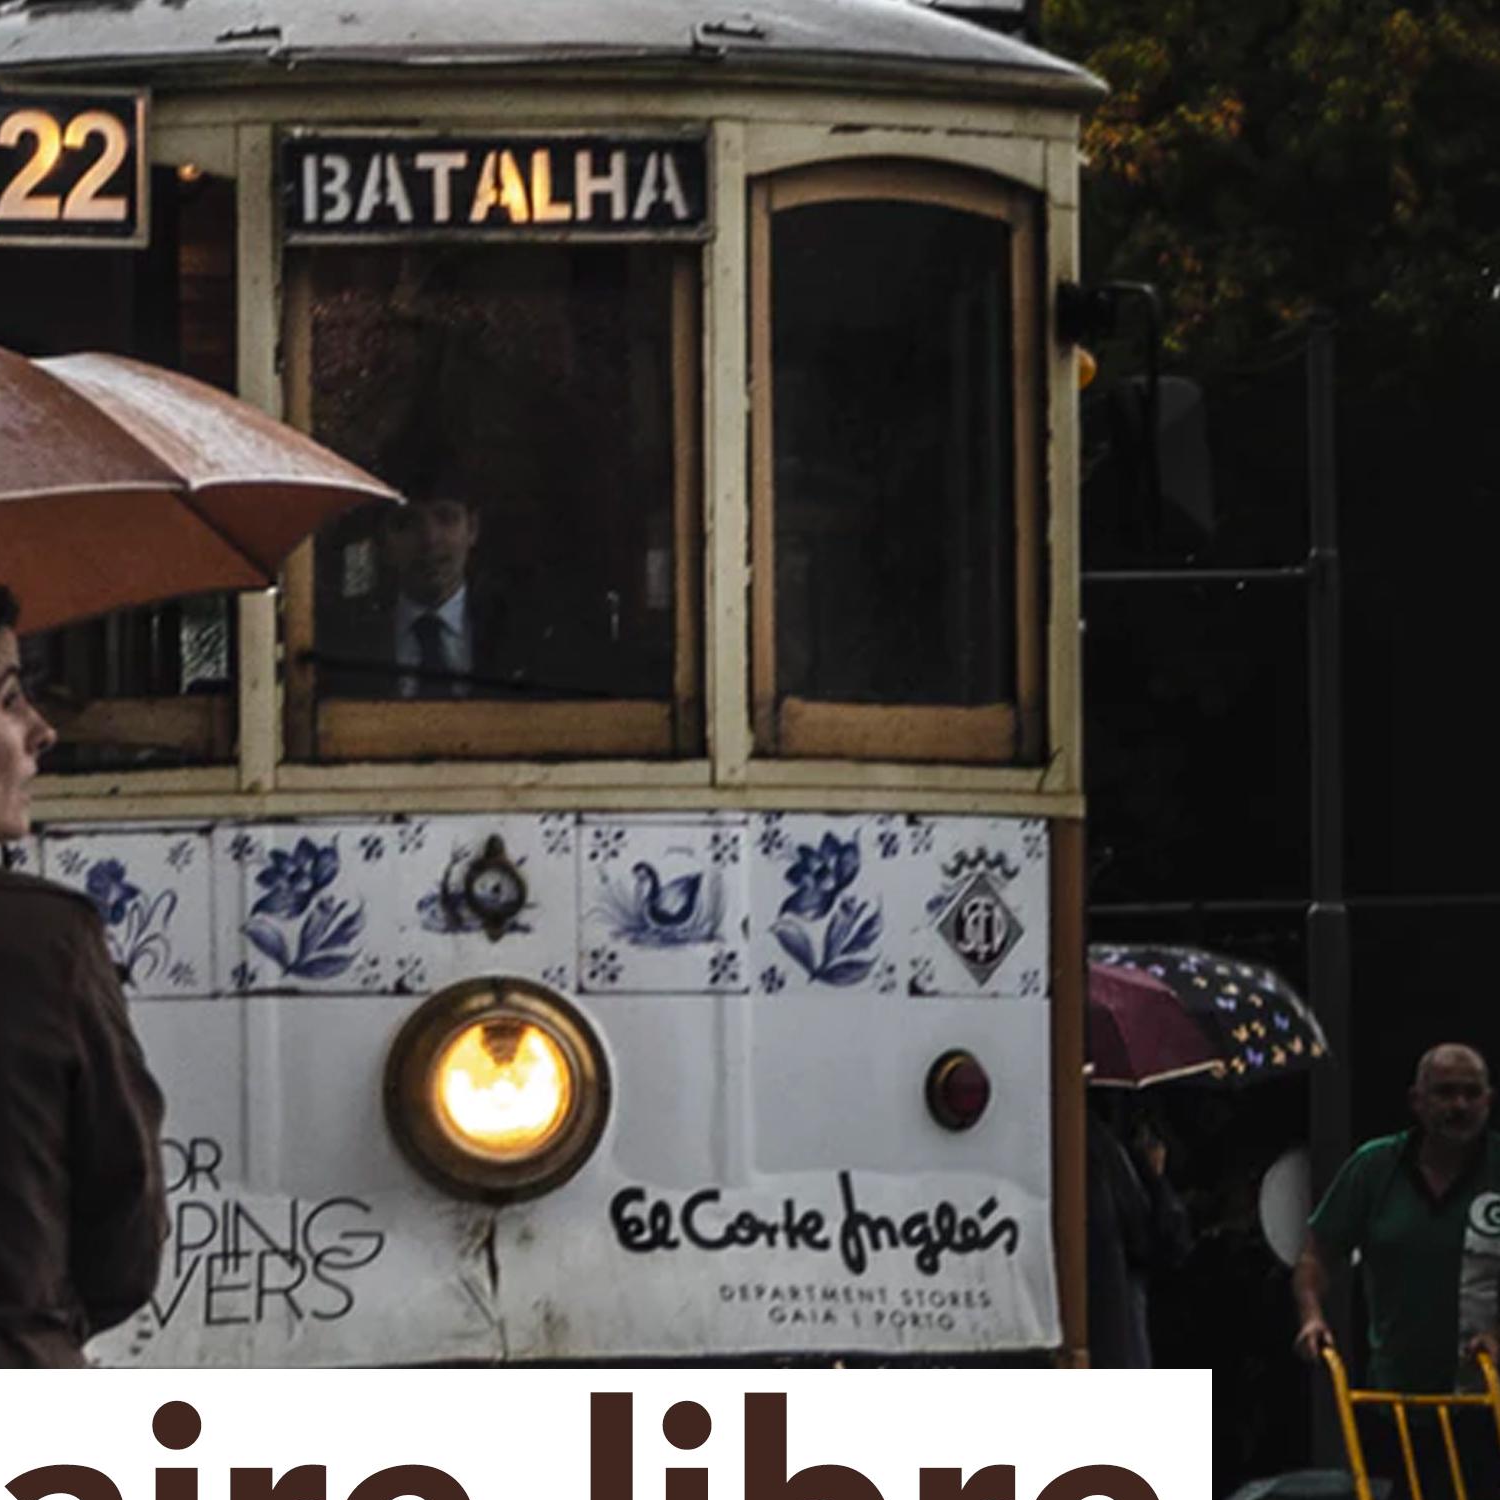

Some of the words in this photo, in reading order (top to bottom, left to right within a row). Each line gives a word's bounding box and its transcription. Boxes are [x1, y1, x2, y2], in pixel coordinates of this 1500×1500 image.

[303, 150, 687, 222] BATALHA
[610, 1187, 680, 1253] El
[681, 1190, 831, 1250] Corte
[839, 1170, 1019, 1276] Inglés
[718, 1283, 888, 1306] DEPARTMENT
[901, 1287, 992, 1310] STORES
[768, 1305, 837, 1326] GAIA
[874, 1308, 956, 1332] PORTO
